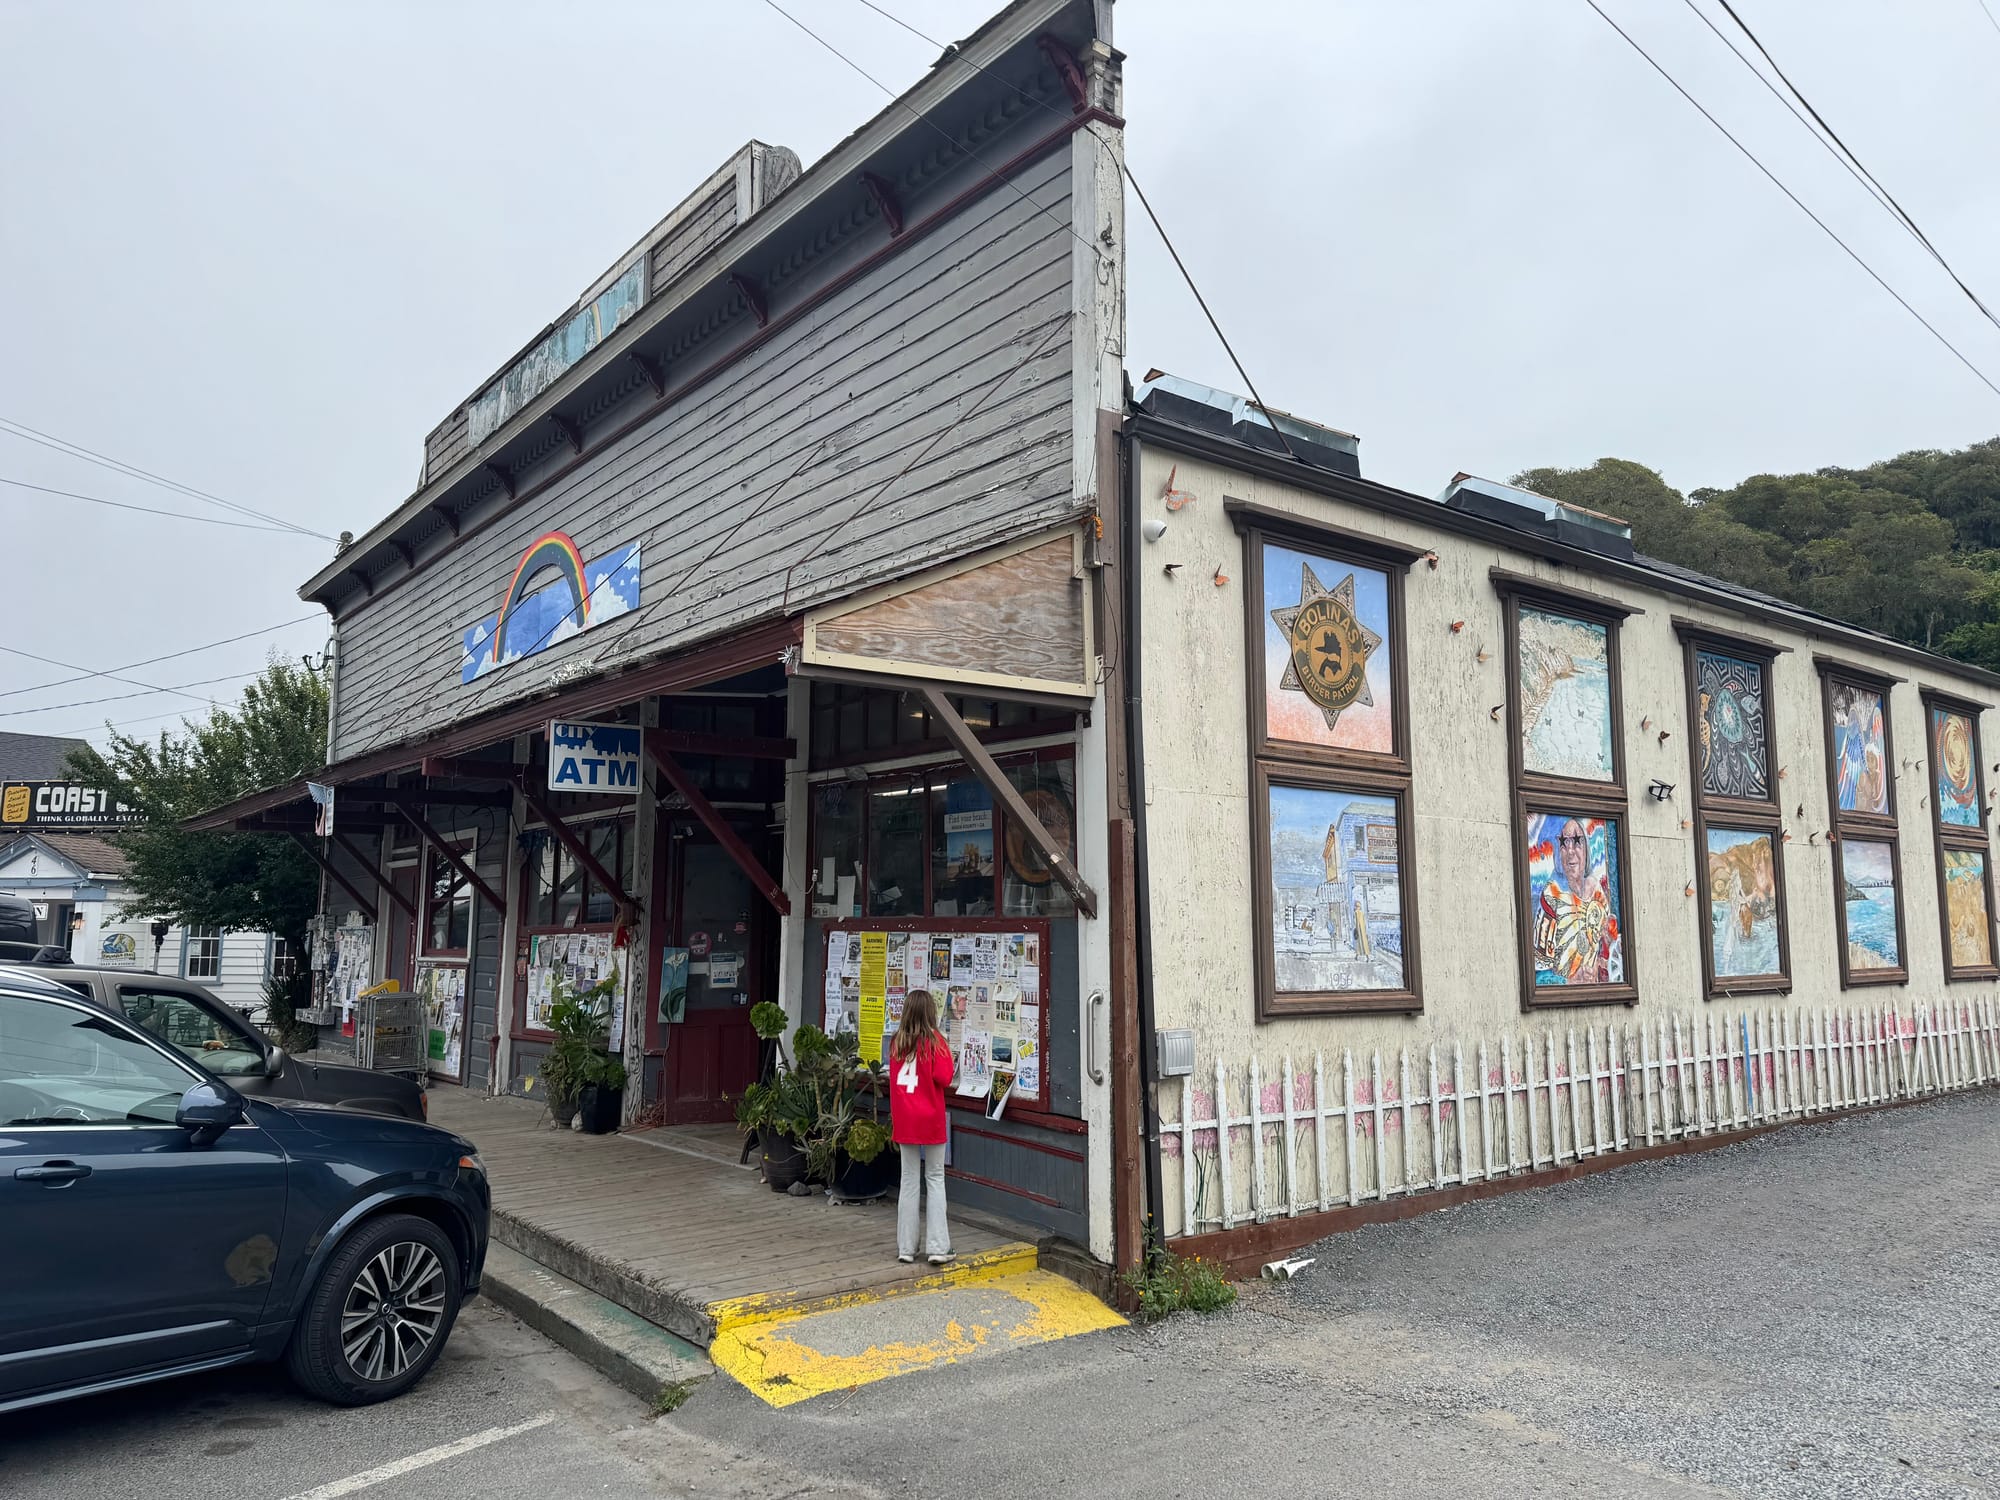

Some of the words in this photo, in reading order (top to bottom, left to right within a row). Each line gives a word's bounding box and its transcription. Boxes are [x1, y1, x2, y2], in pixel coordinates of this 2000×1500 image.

[1299, 604, 1360, 645] BOLINAS
[1301, 664, 1331, 700] BIRDER
[1332, 675, 1360, 701] PATROL
[556, 724, 598, 740] CITY
[555, 757, 637, 787] ATM
[36, 786, 108, 813] COAST
[30, 855, 38, 875] 46
[1330, 972, 1353, 987] 1956
[897, 1058, 919, 1094] 4
